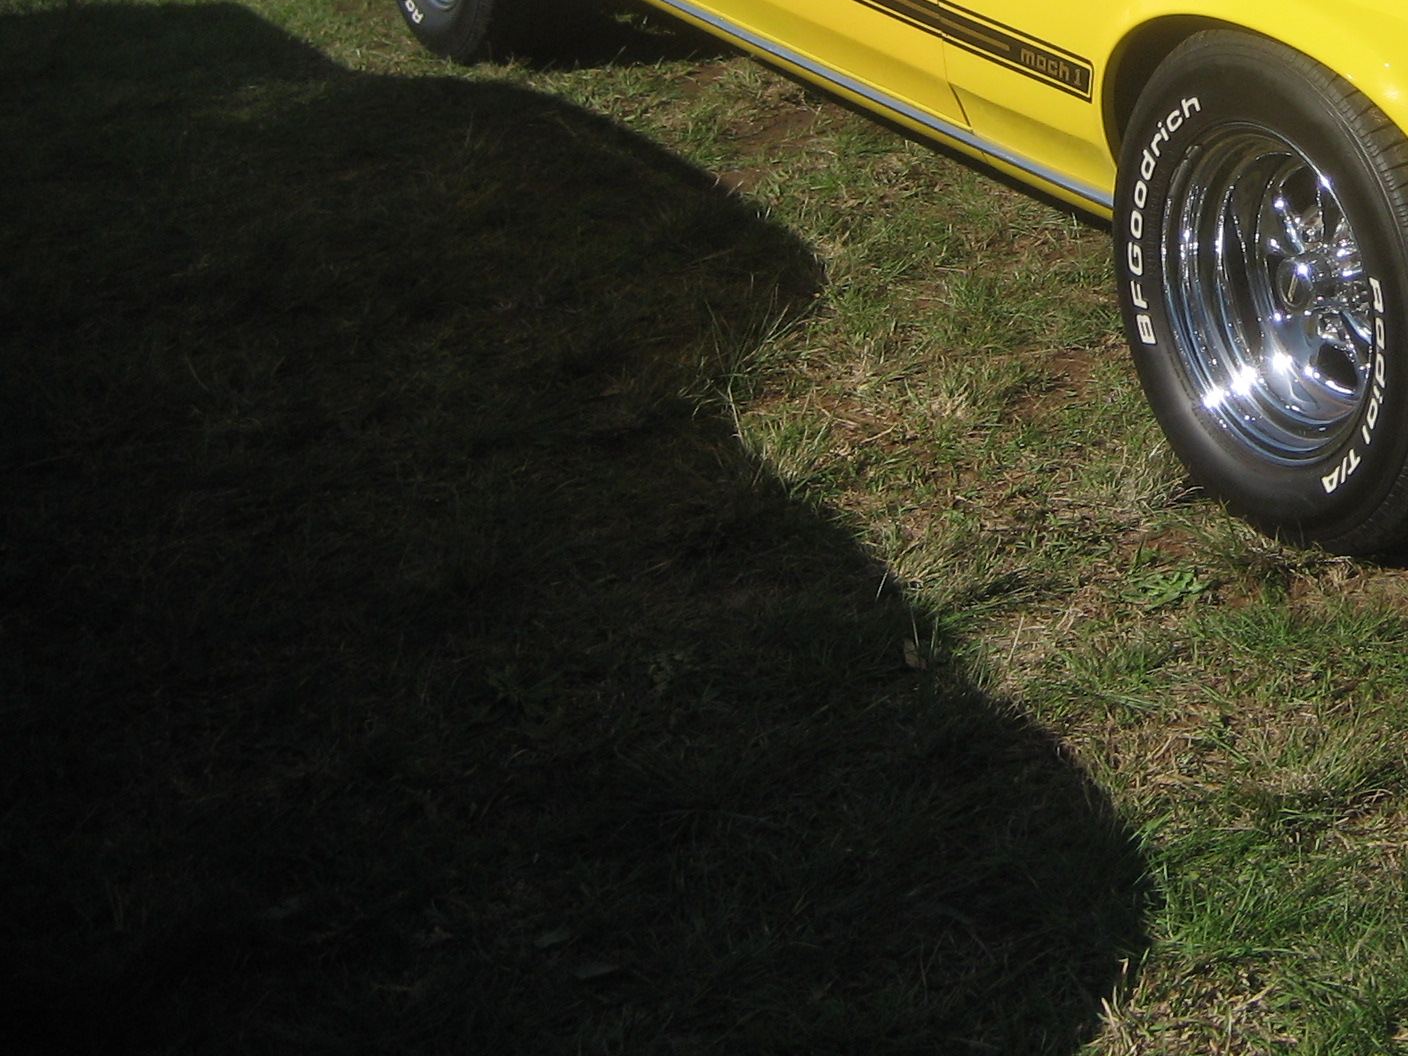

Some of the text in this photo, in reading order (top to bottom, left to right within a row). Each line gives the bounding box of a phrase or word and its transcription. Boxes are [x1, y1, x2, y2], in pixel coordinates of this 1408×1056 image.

[1020, 47, 1082, 86] mach 1
[1127, 96, 1202, 345] BFGoodrich
[1321, 276, 1386, 494] Radial T/A
